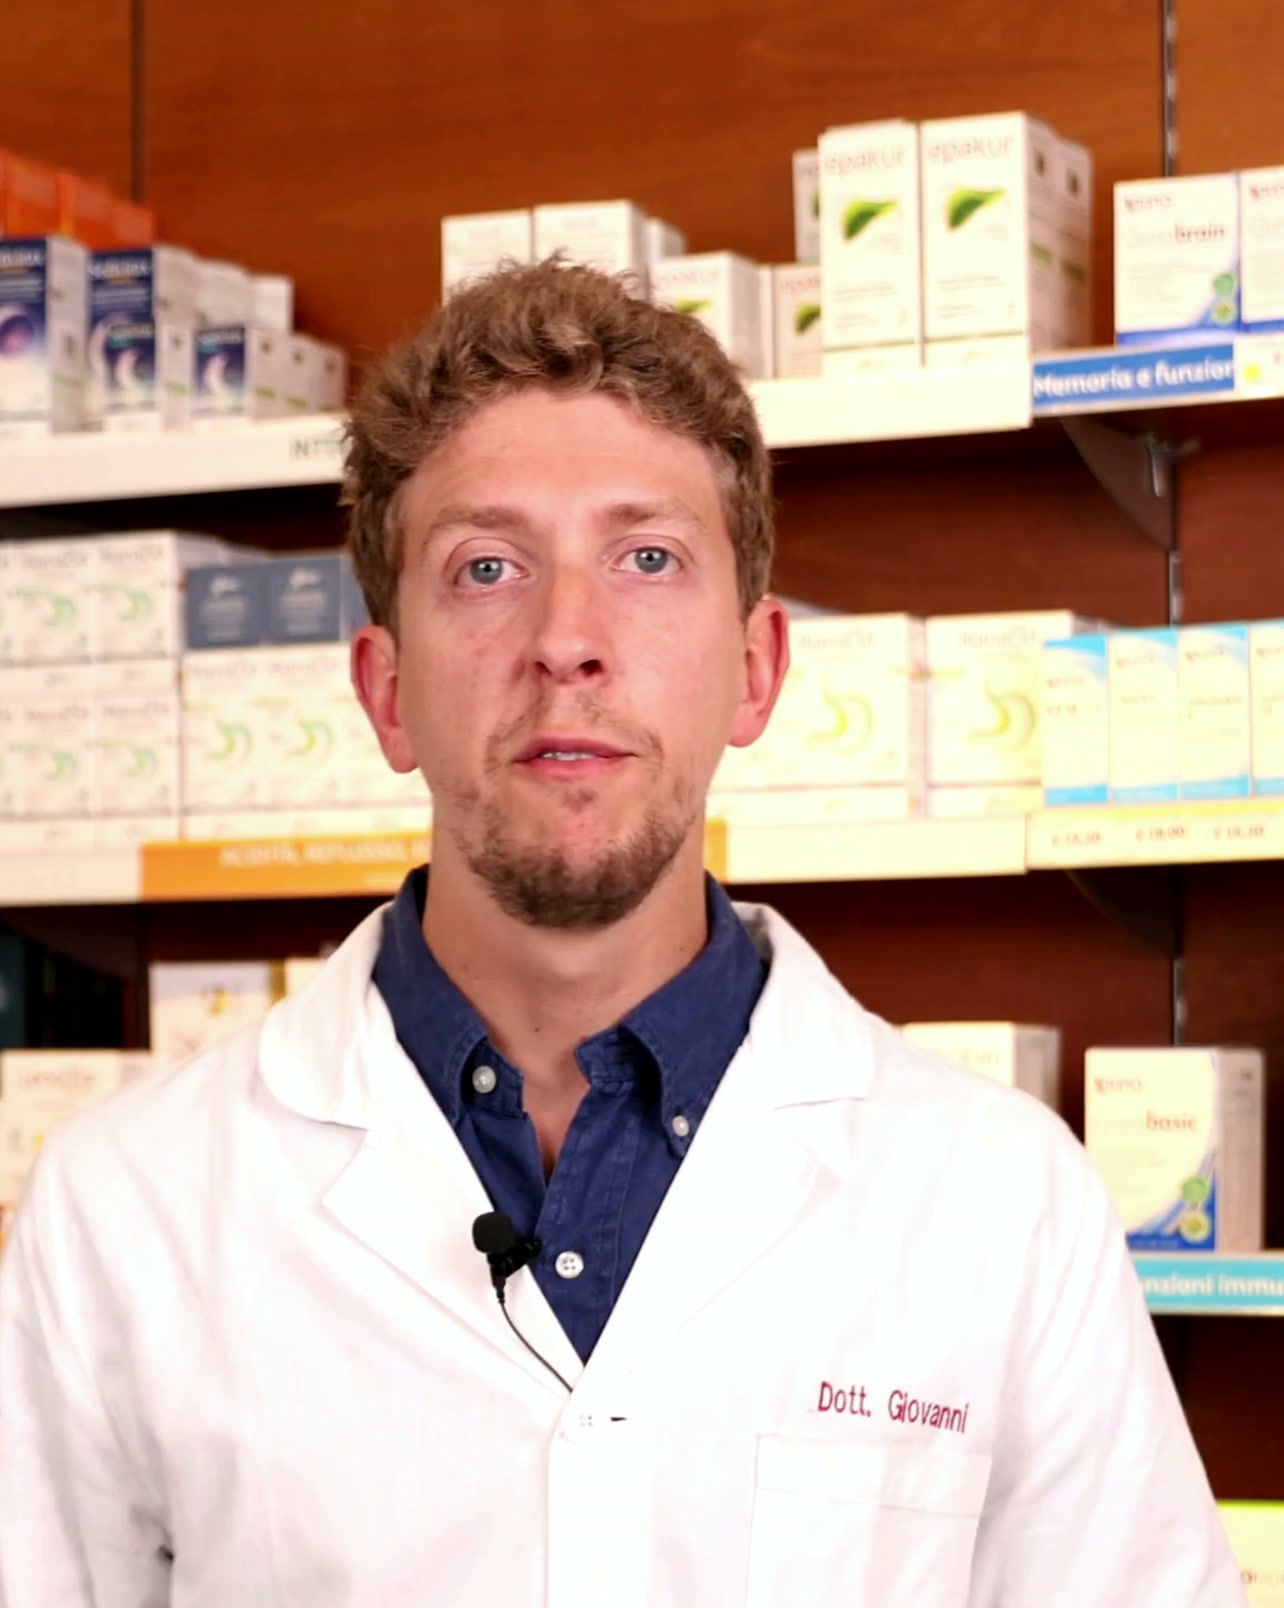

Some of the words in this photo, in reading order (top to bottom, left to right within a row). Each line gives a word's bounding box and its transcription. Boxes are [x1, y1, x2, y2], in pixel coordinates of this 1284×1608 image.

[1033, 366, 1132, 398] Memoria
[1135, 367, 1150, 390] e
[817, 1380, 872, 1418] Dott.
[888, 1389, 970, 1435] Giovanni
